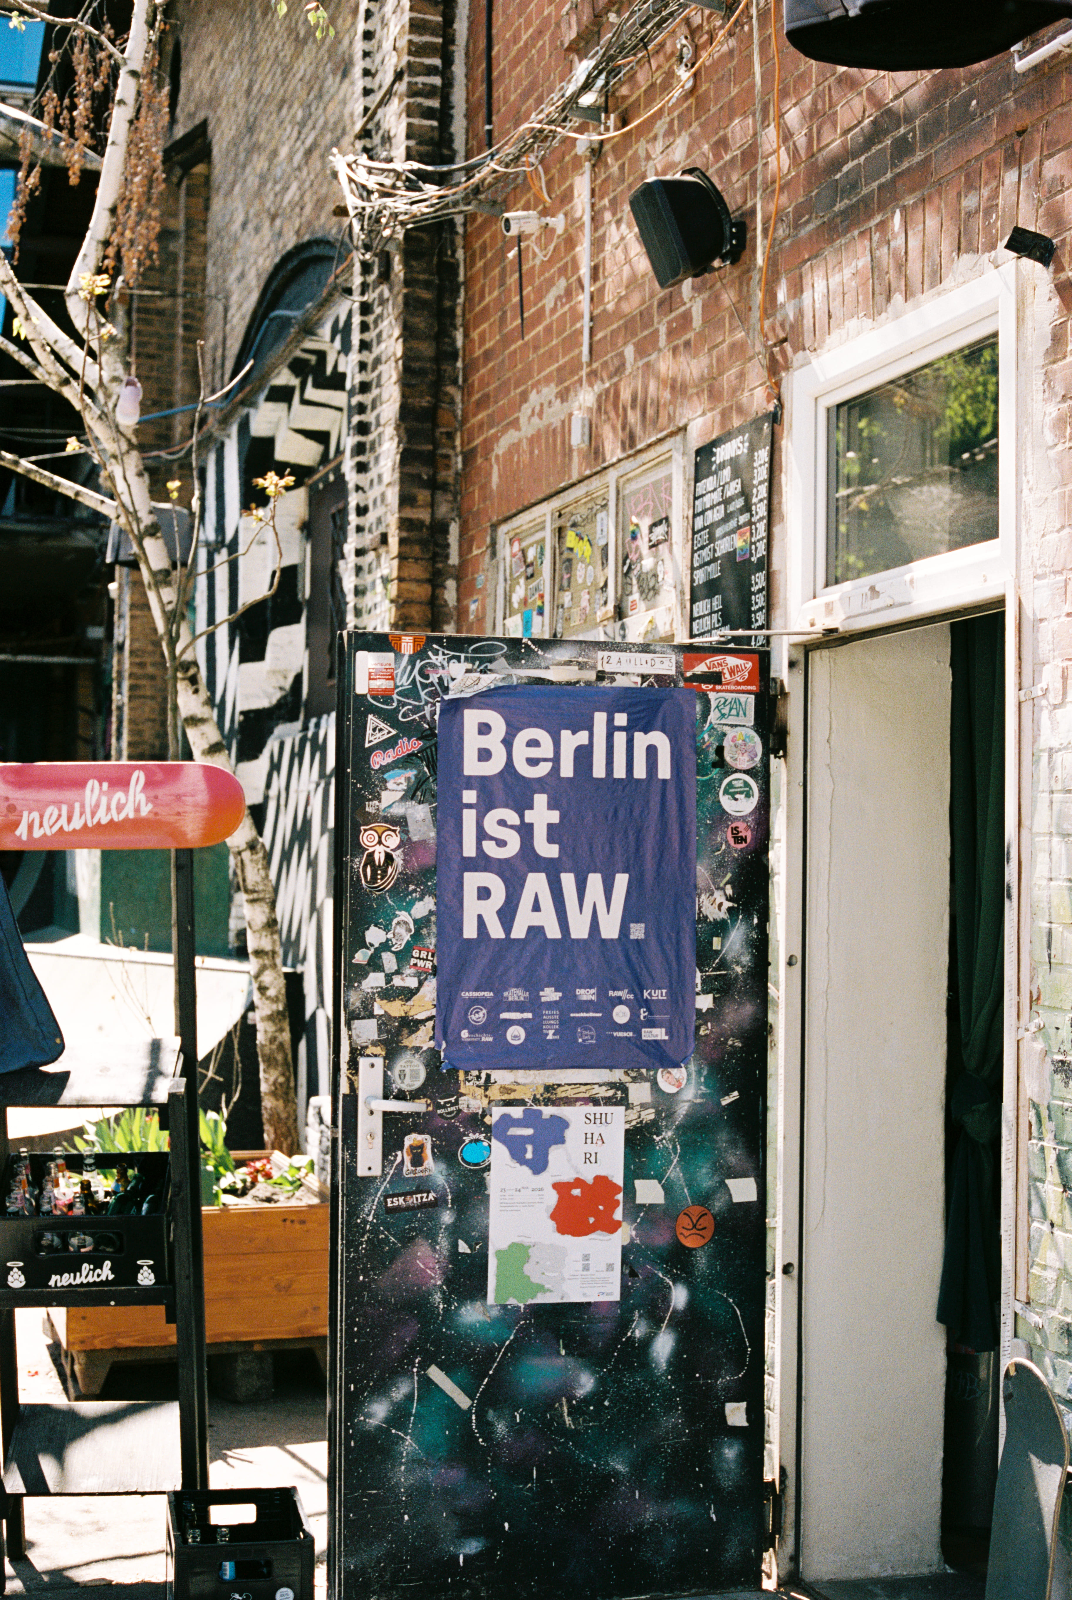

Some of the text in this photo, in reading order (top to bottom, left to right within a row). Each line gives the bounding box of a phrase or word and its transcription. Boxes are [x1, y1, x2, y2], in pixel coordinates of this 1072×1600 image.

[716, 436, 743, 464] DRINKS
[712, 611, 723, 628] PILS
[705, 657, 728, 671] VANS
[463, 709, 671, 779] Berlin
[370, 737, 423, 769] Radio
[15, 769, 153, 841] neulich
[462, 789, 560, 859] ist
[732, 835, 748, 845] TEN
[412, 949, 433, 961] GRL
[410, 957, 433, 970] PWR
[643, 989, 667, 999] KULT
[584, 1112, 614, 1125] SHU
[584, 1132, 605, 1144] HA
[584, 1151, 598, 1164] RI
[48, 1260, 115, 1287] neulich
